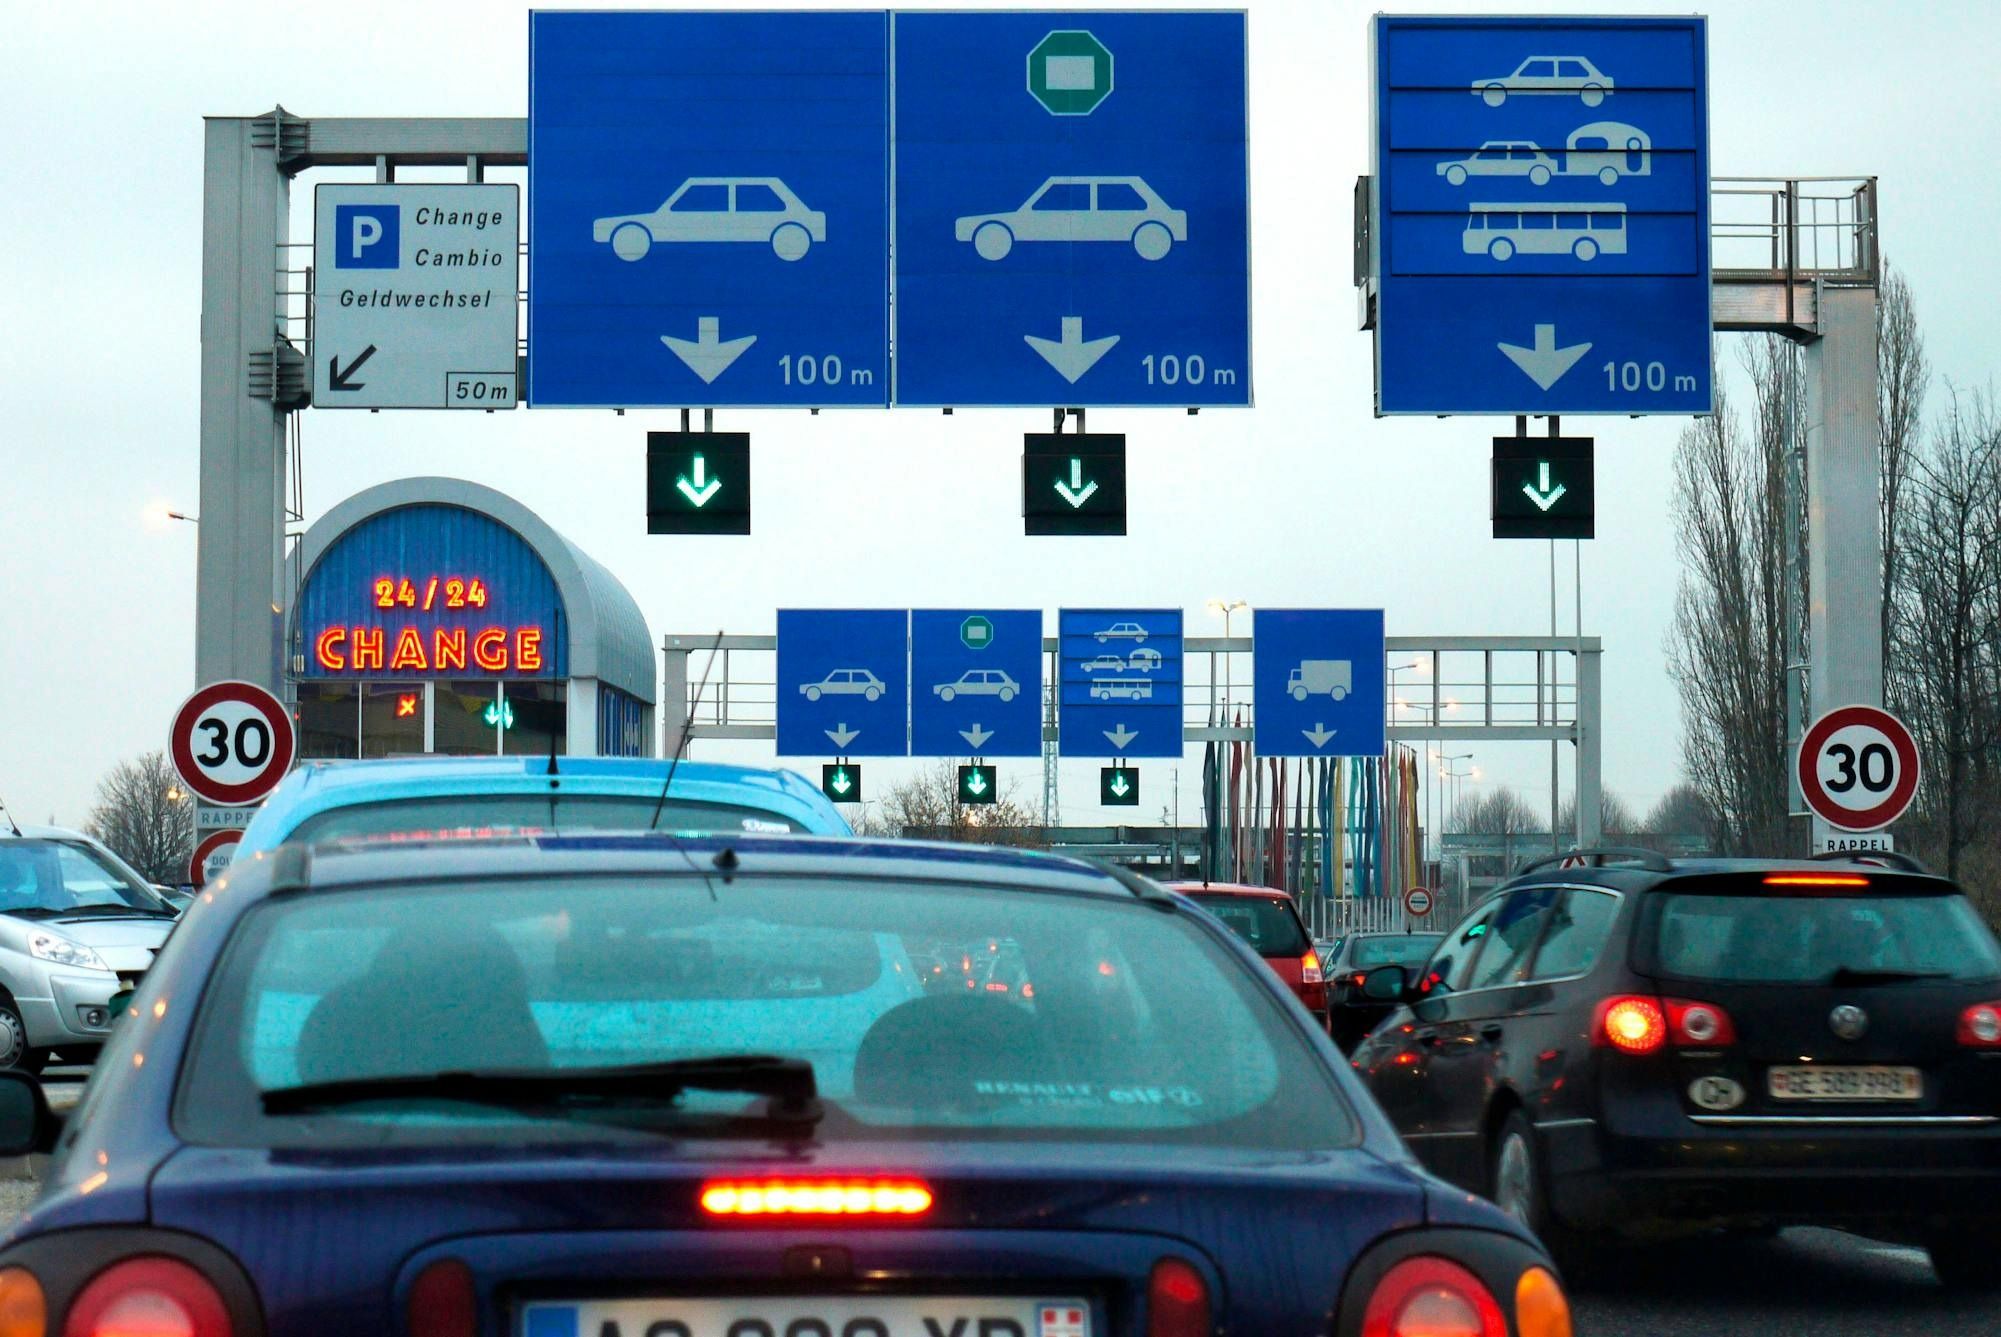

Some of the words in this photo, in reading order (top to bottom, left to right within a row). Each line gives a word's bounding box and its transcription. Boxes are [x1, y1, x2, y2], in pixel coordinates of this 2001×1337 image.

[416, 208, 503, 230] Change
[353, 216, 383, 258] P
[415, 249, 502, 267] Cambio
[340, 289, 491, 307] Geldwechsel
[318, 627, 542, 671] CHANGE
[197, 717, 270, 768] 30
[1825, 743, 1894, 793] 30
[201, 811, 256, 825] RAPPE
[1827, 839, 1889, 851] RAPPEL
